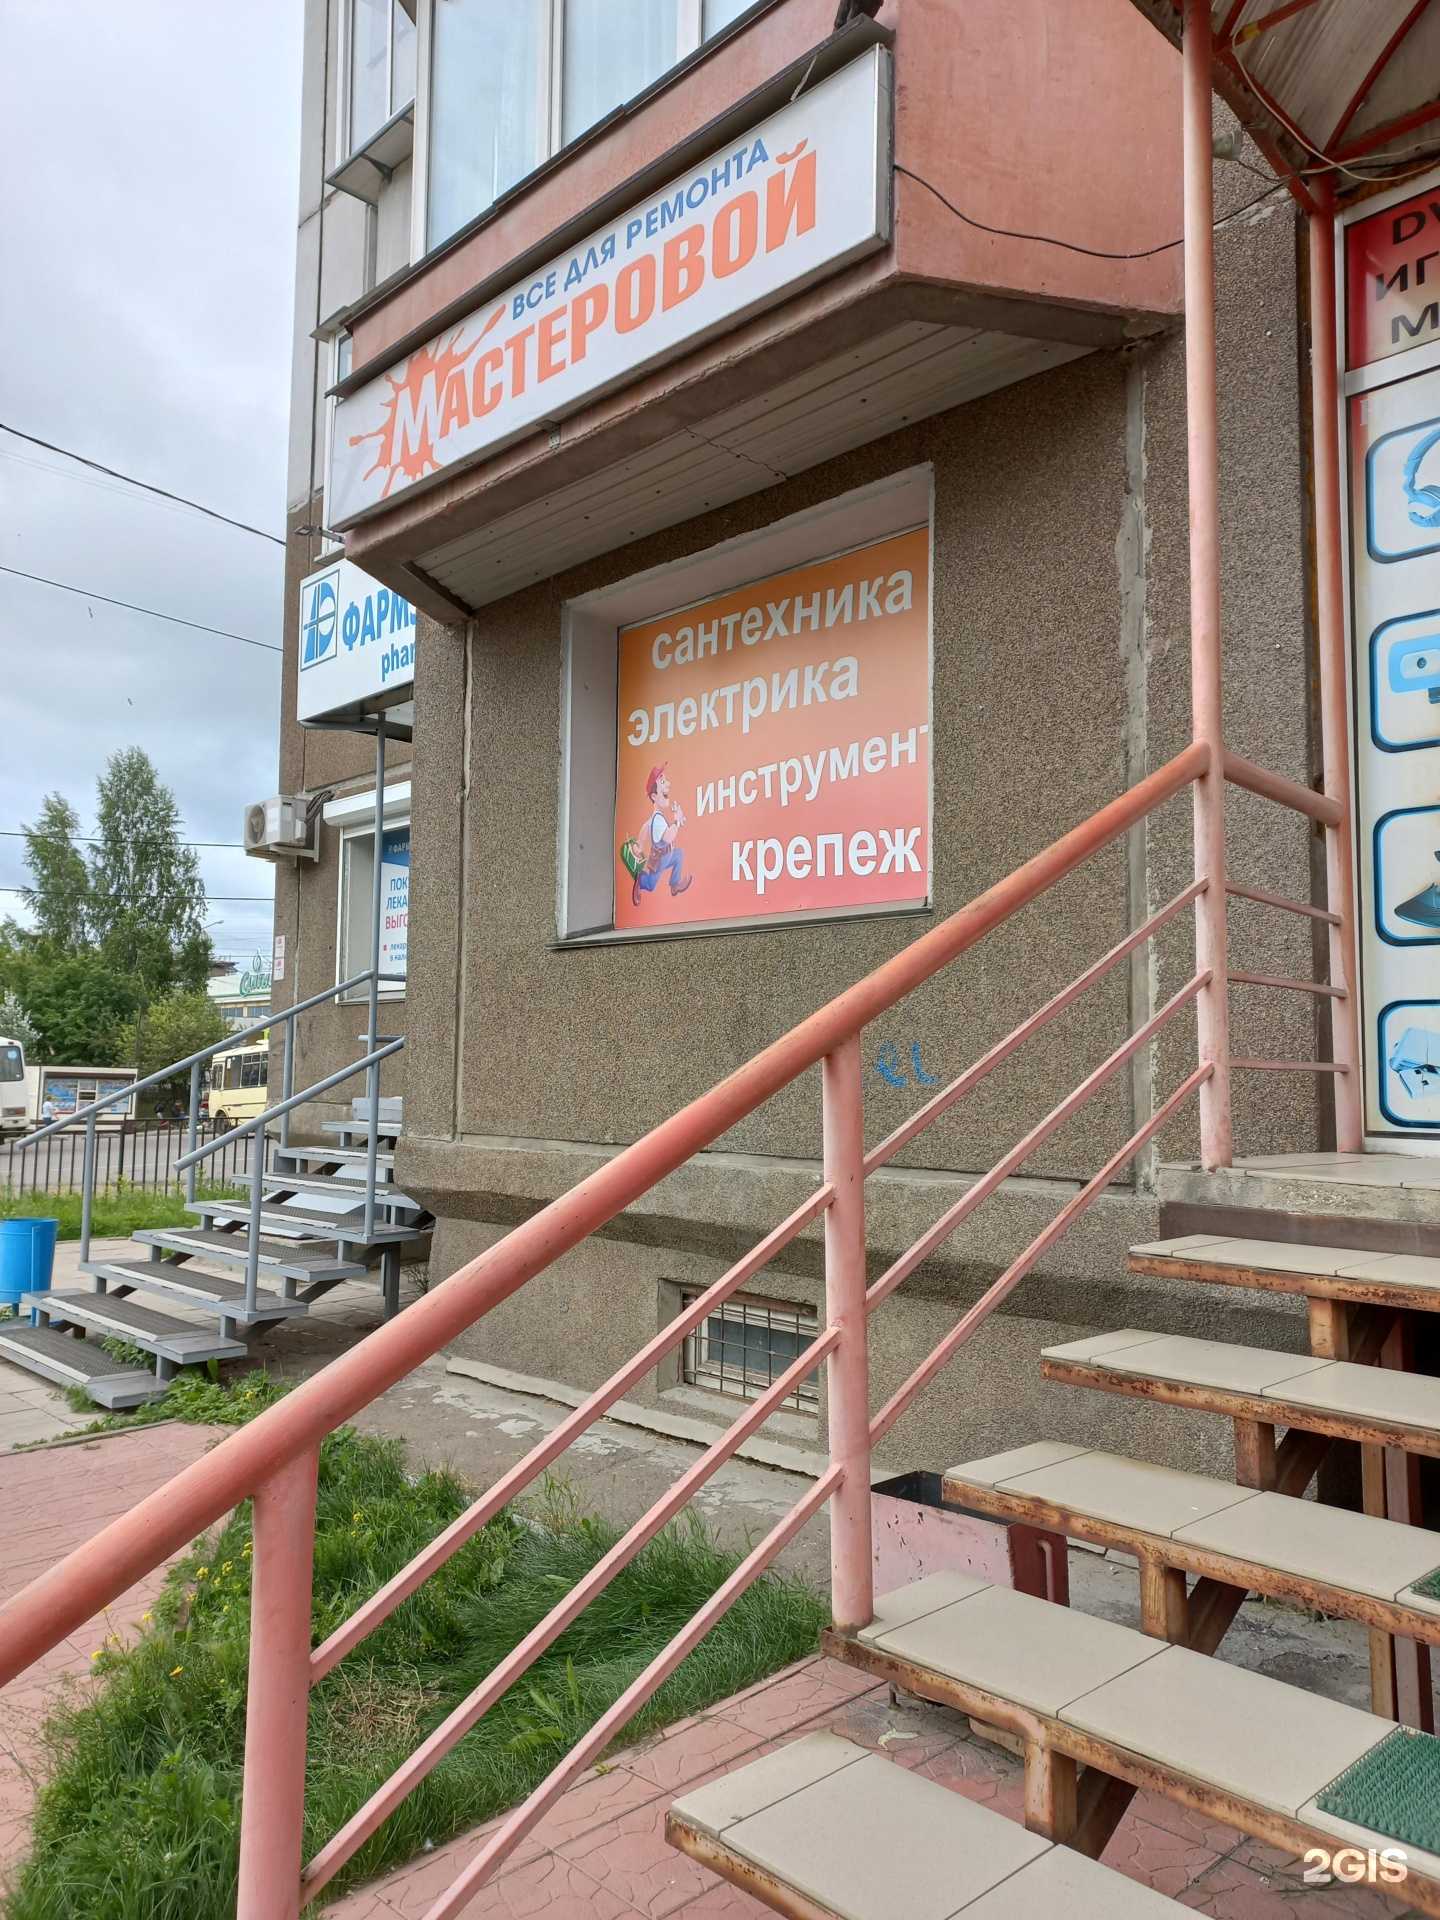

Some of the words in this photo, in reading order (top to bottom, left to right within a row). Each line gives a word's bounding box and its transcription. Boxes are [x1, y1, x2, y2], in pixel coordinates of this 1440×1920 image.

[512, 271, 556, 320] ВСЕ
[564, 235, 616, 292] ДЛЯ
[626, 138, 769, 249] РЕМОНТА
[652, 569, 913, 669] сантехника
[627, 656, 859, 747] электрика
[696, 724, 928, 817] инструмен
[731, 827, 922, 894] крепеж
